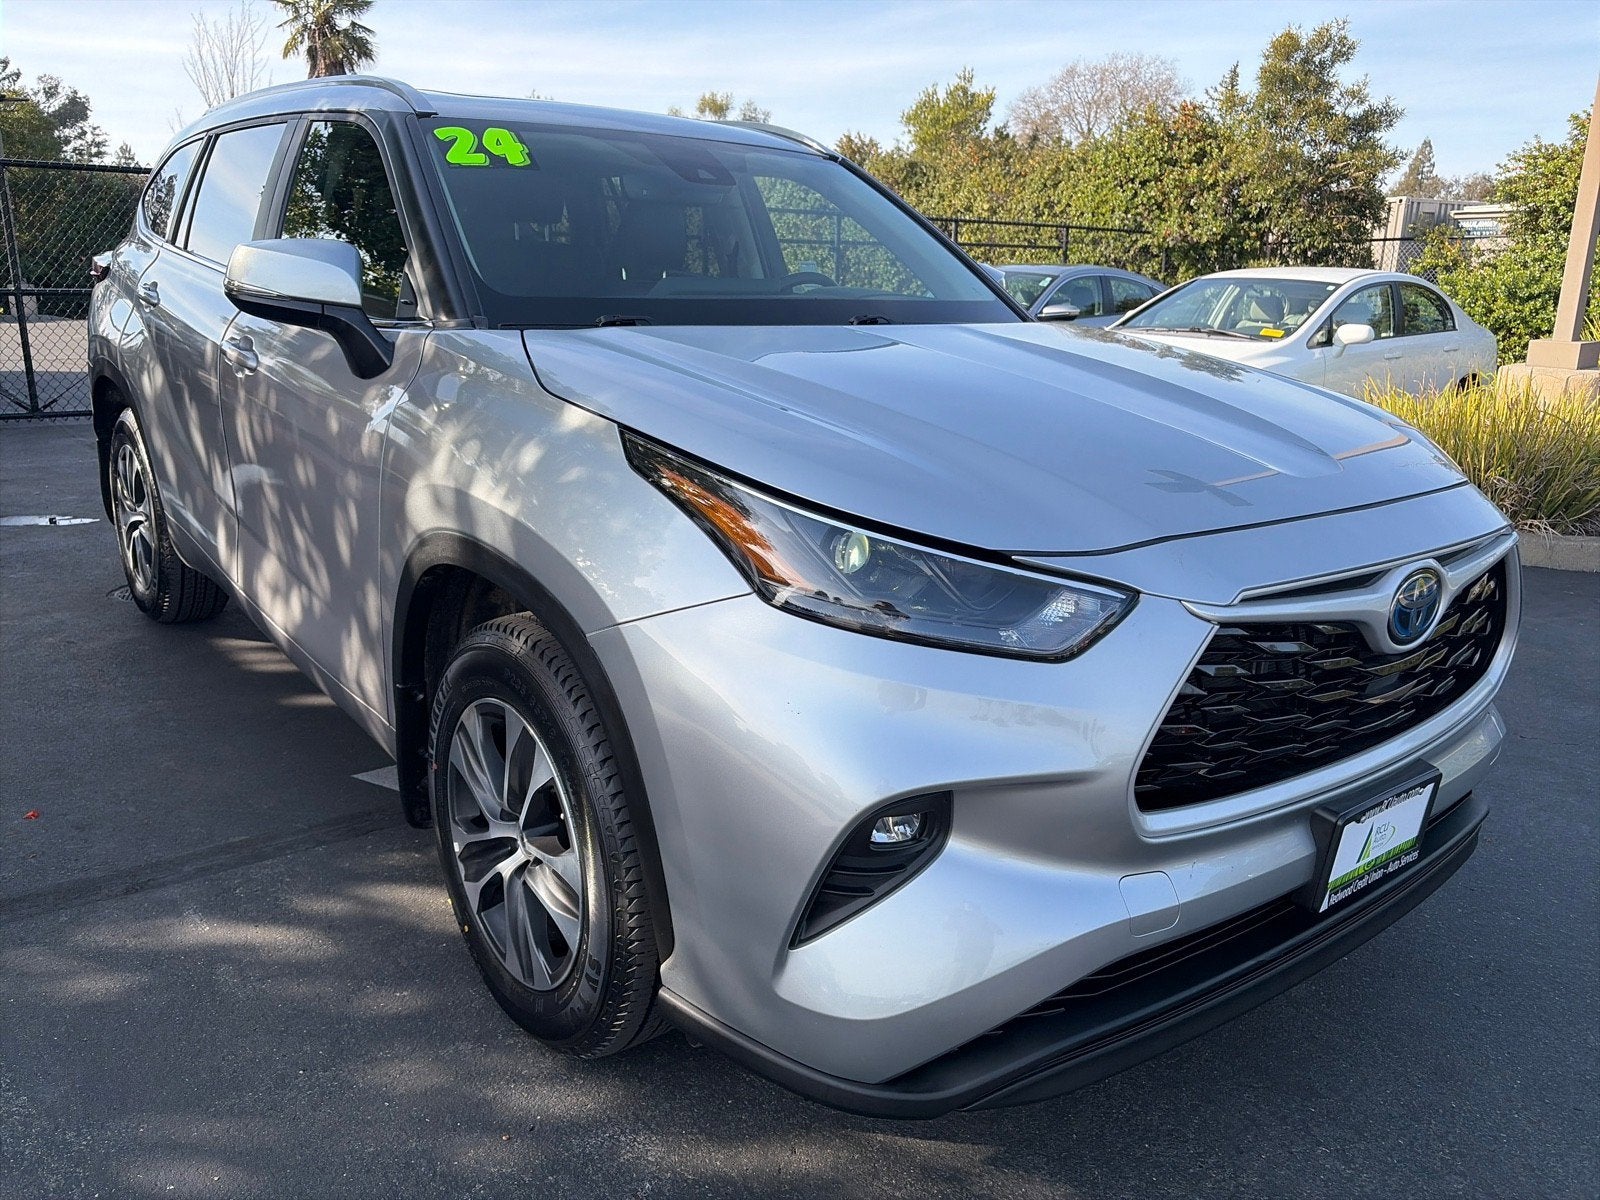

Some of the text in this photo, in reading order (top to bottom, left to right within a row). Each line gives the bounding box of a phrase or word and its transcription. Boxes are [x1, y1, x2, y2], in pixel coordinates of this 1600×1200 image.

[433, 126, 531, 167] 24
[1329, 886, 1353, 906] Redwood
[1352, 875, 1369, 892] Credit
[1368, 868, 1384, 884] Union
[1388, 860, 1401, 873] Auto
[1400, 850, 1420, 867] Services
